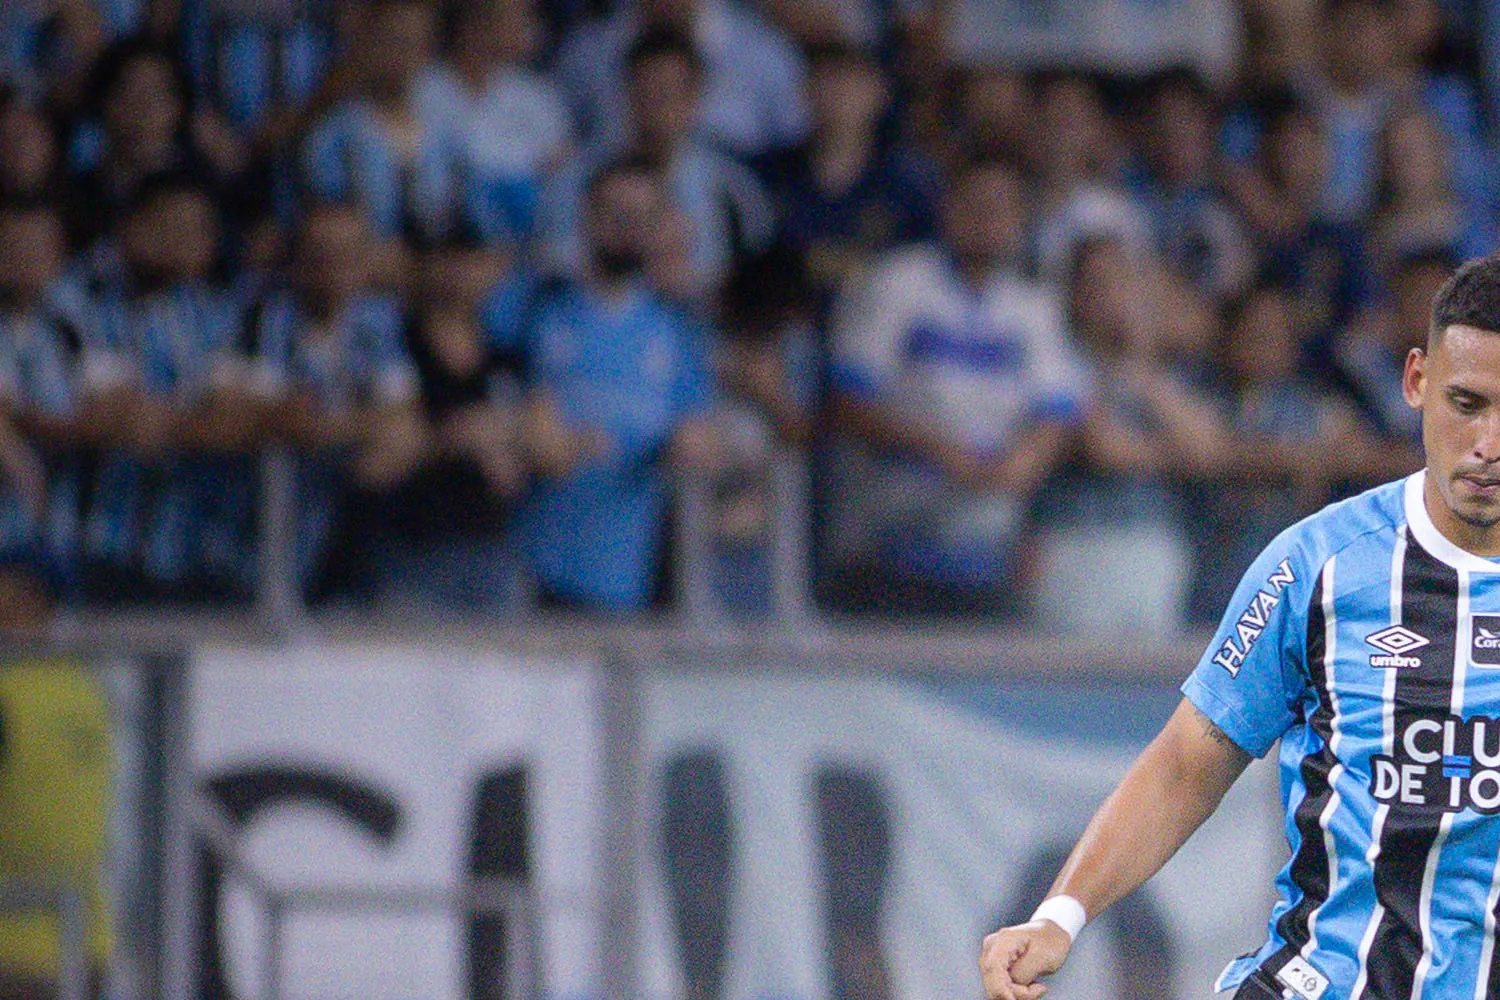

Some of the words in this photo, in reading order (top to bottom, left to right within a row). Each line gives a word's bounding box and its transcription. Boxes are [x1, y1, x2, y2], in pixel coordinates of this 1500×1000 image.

[1212, 556, 1296, 680] HAVAN
[1369, 655, 1422, 669] umbro
[1372, 759, 1428, 805] DE
